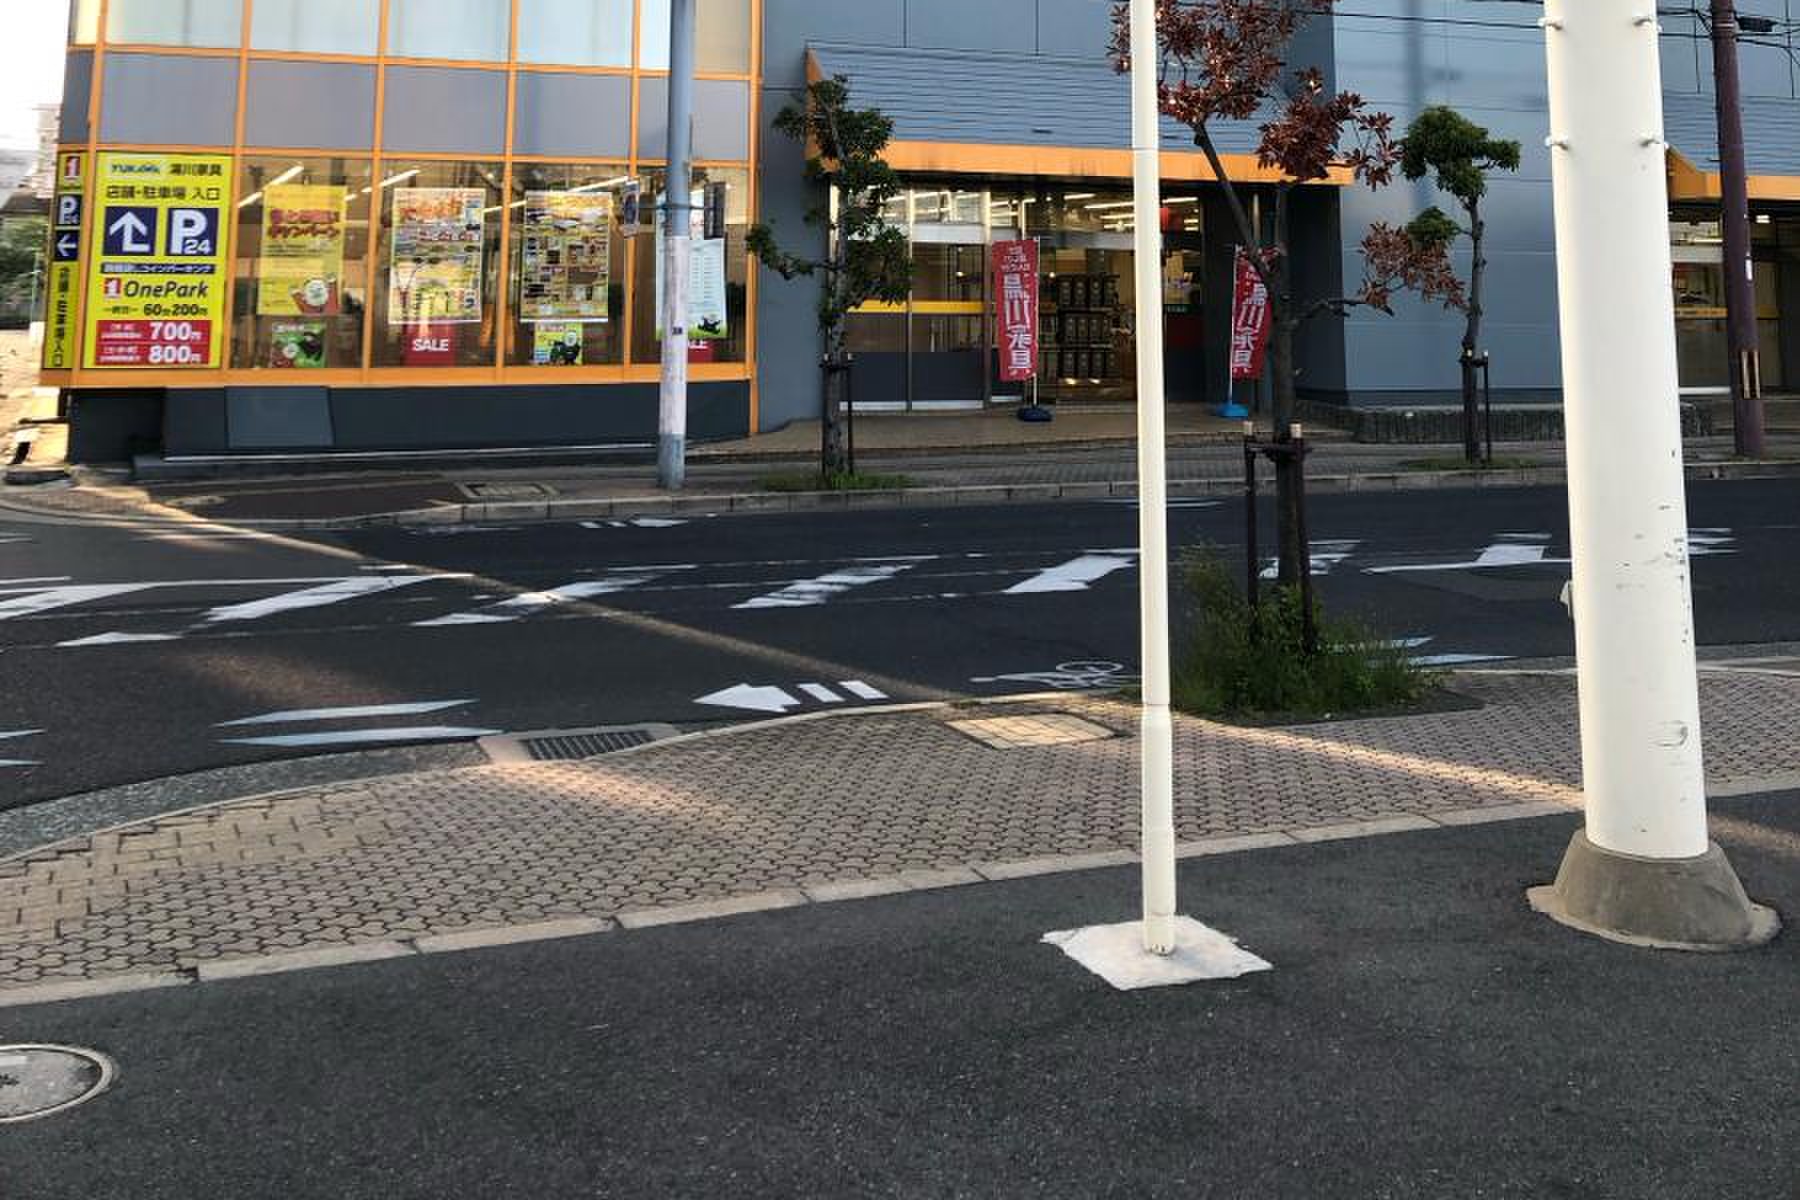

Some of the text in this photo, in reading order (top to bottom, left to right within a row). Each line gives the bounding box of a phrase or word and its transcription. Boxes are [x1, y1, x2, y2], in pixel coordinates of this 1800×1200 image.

[192, 187, 220, 200] 入口
[170, 209, 212, 254] P 24
[125, 280, 208, 298] OnePark
[413, 338, 449, 352] SALE
